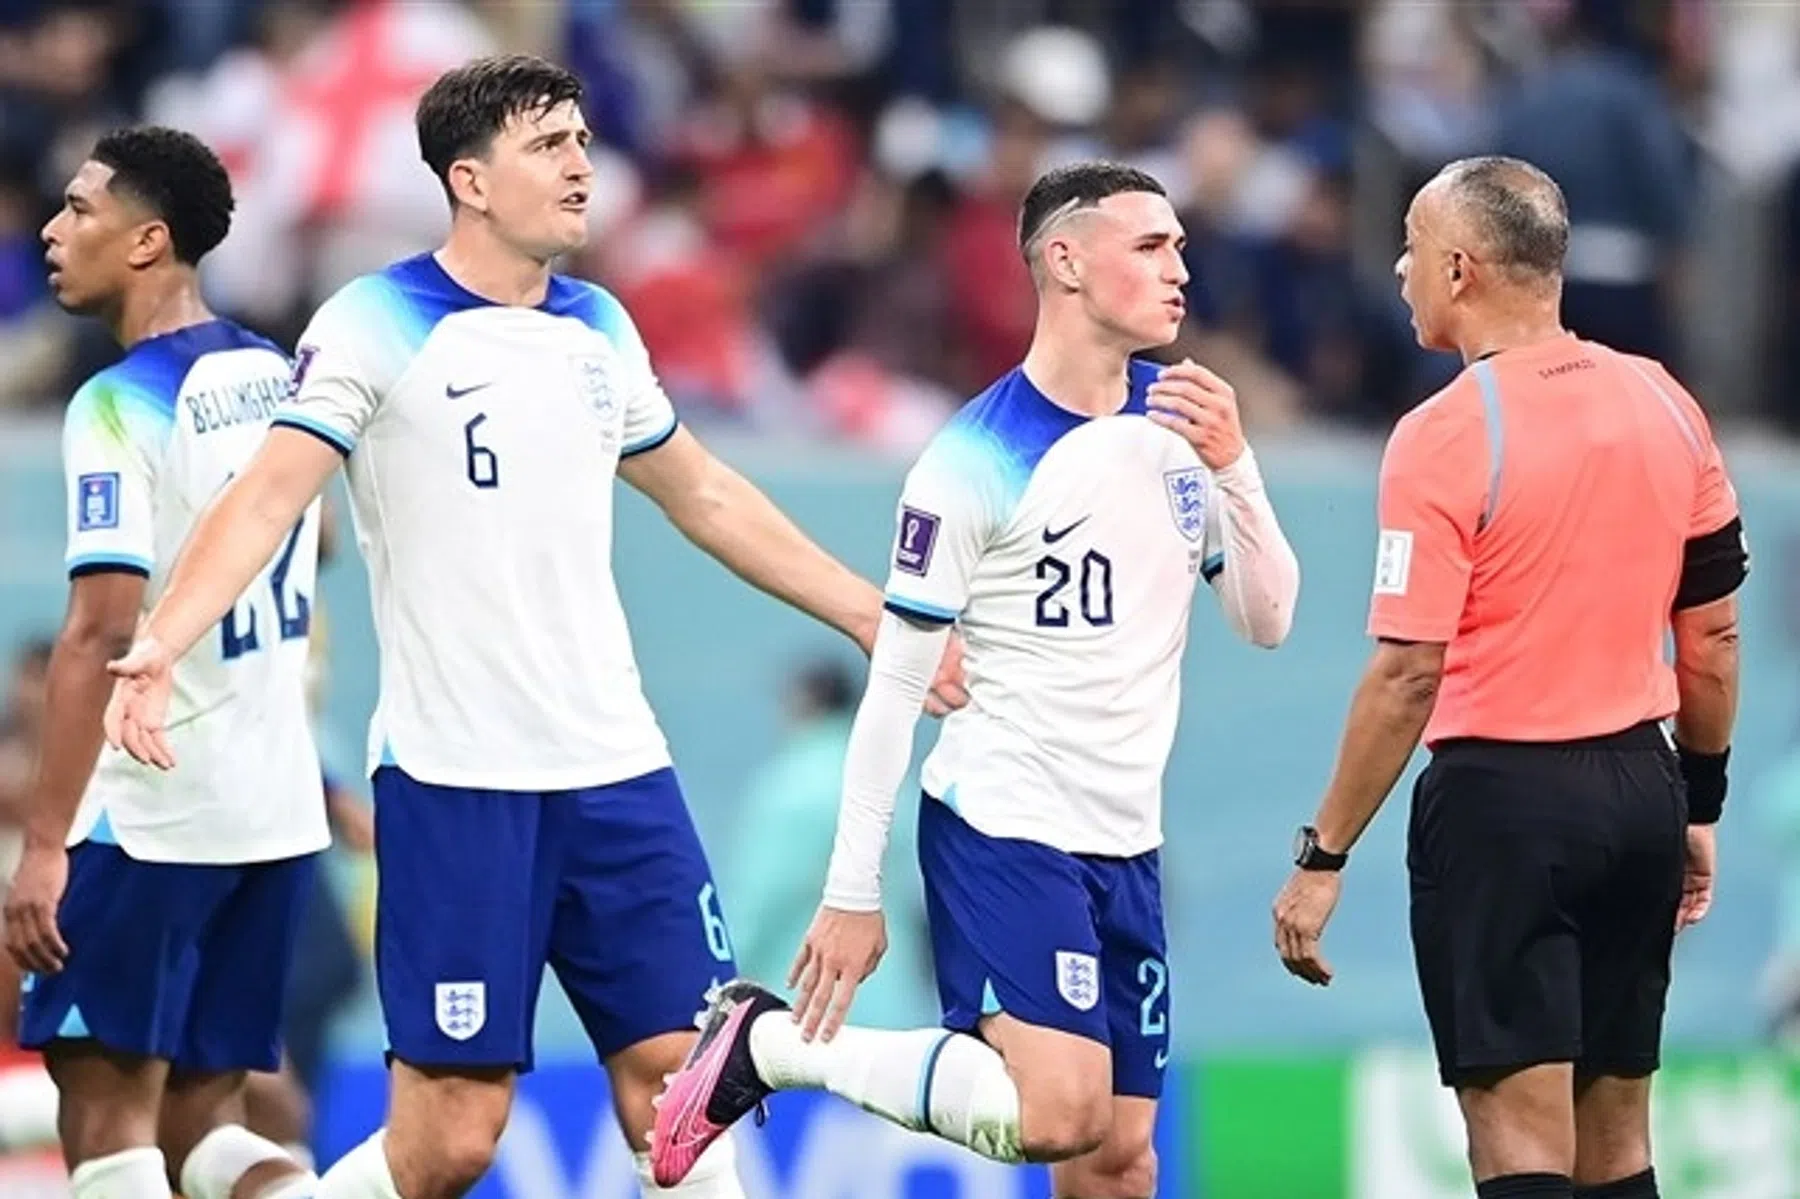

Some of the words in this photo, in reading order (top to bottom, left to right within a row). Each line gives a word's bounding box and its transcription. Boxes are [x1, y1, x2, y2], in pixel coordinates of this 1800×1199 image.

[465, 412, 499, 489] 6
[1035, 548, 1114, 627] 20
[698, 881, 732, 961] 6
